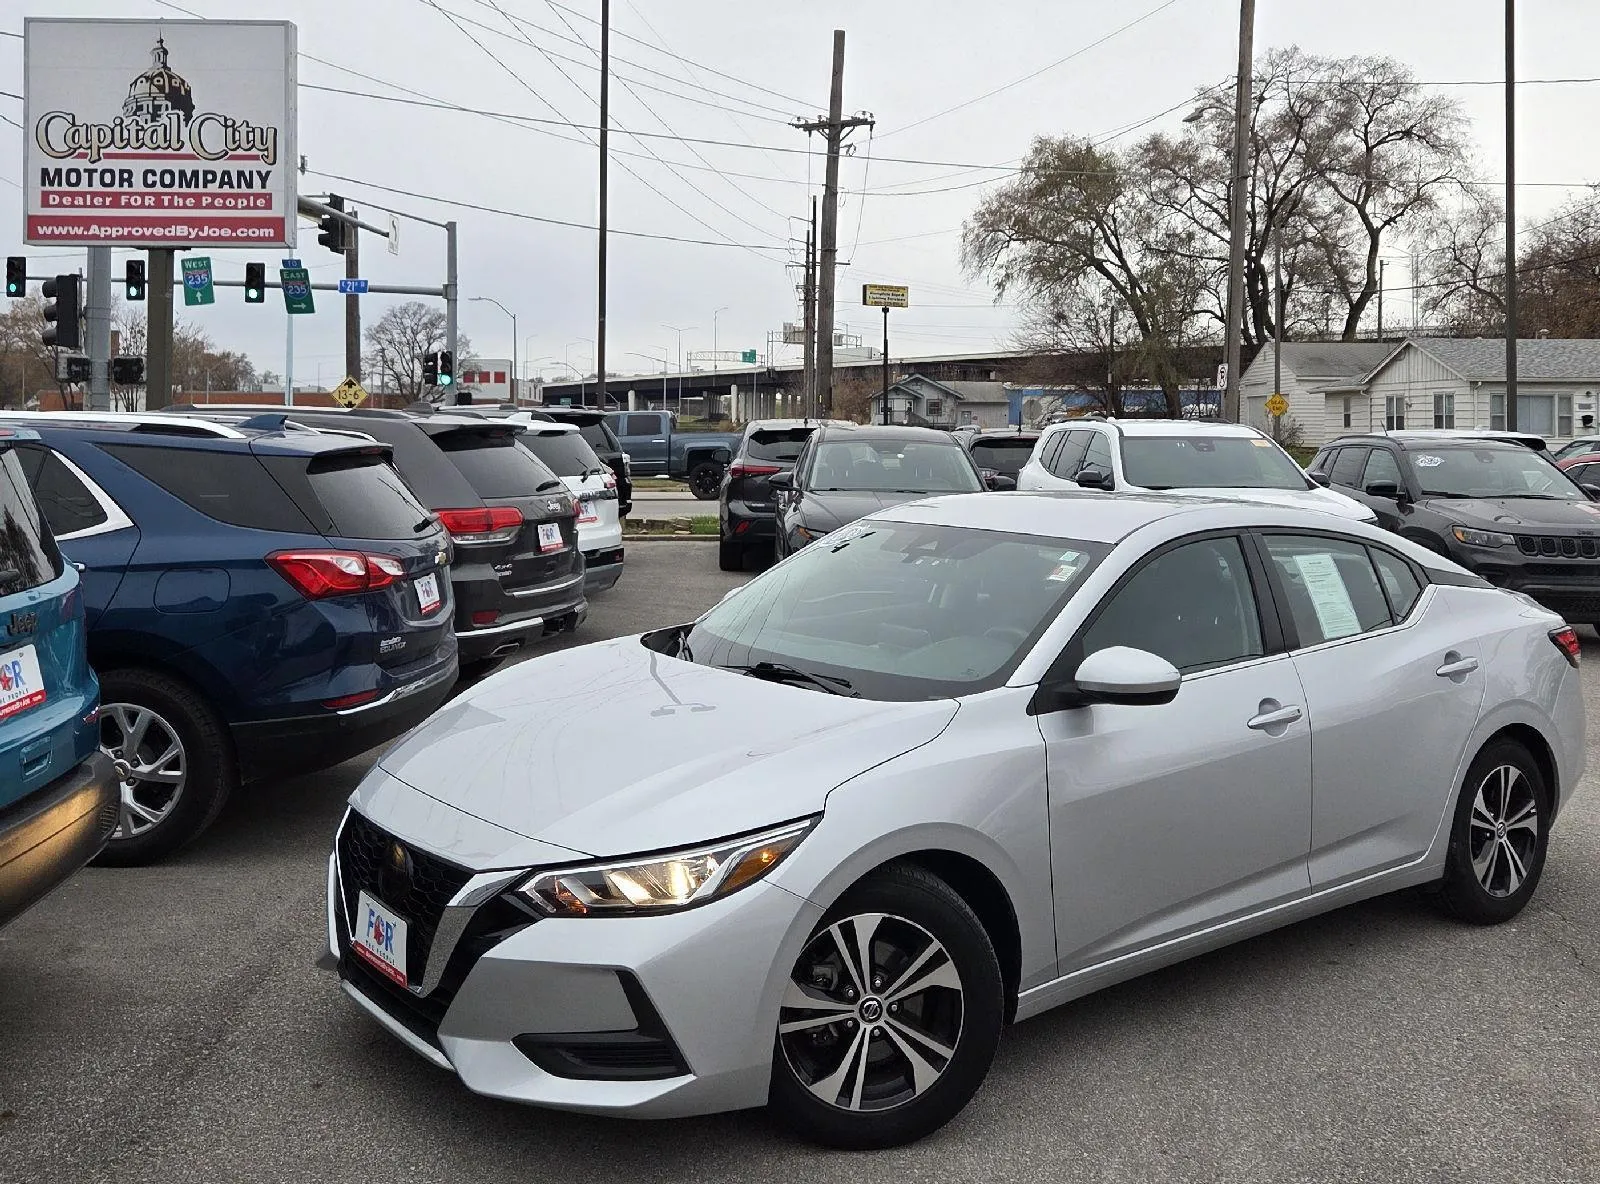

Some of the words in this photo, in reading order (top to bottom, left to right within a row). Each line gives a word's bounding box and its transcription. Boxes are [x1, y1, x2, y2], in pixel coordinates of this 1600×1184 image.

[36, 110, 185, 164] Capital
[188, 112, 278, 165] City
[40, 167, 134, 188] MOTOR
[142, 168, 272, 190] COMPANY
[49, 194, 112, 207] Dealer
[120, 195, 156, 207] FOR
[161, 195, 195, 207] The
[202, 196, 266, 209] People
[37, 224, 275, 238] www.ApprovedByJoe.com
[188, 273, 208, 285] 235
[287, 284, 307, 295] 235
[6, 611, 37, 636] Jeep
[366, 907, 394, 956] FOR
